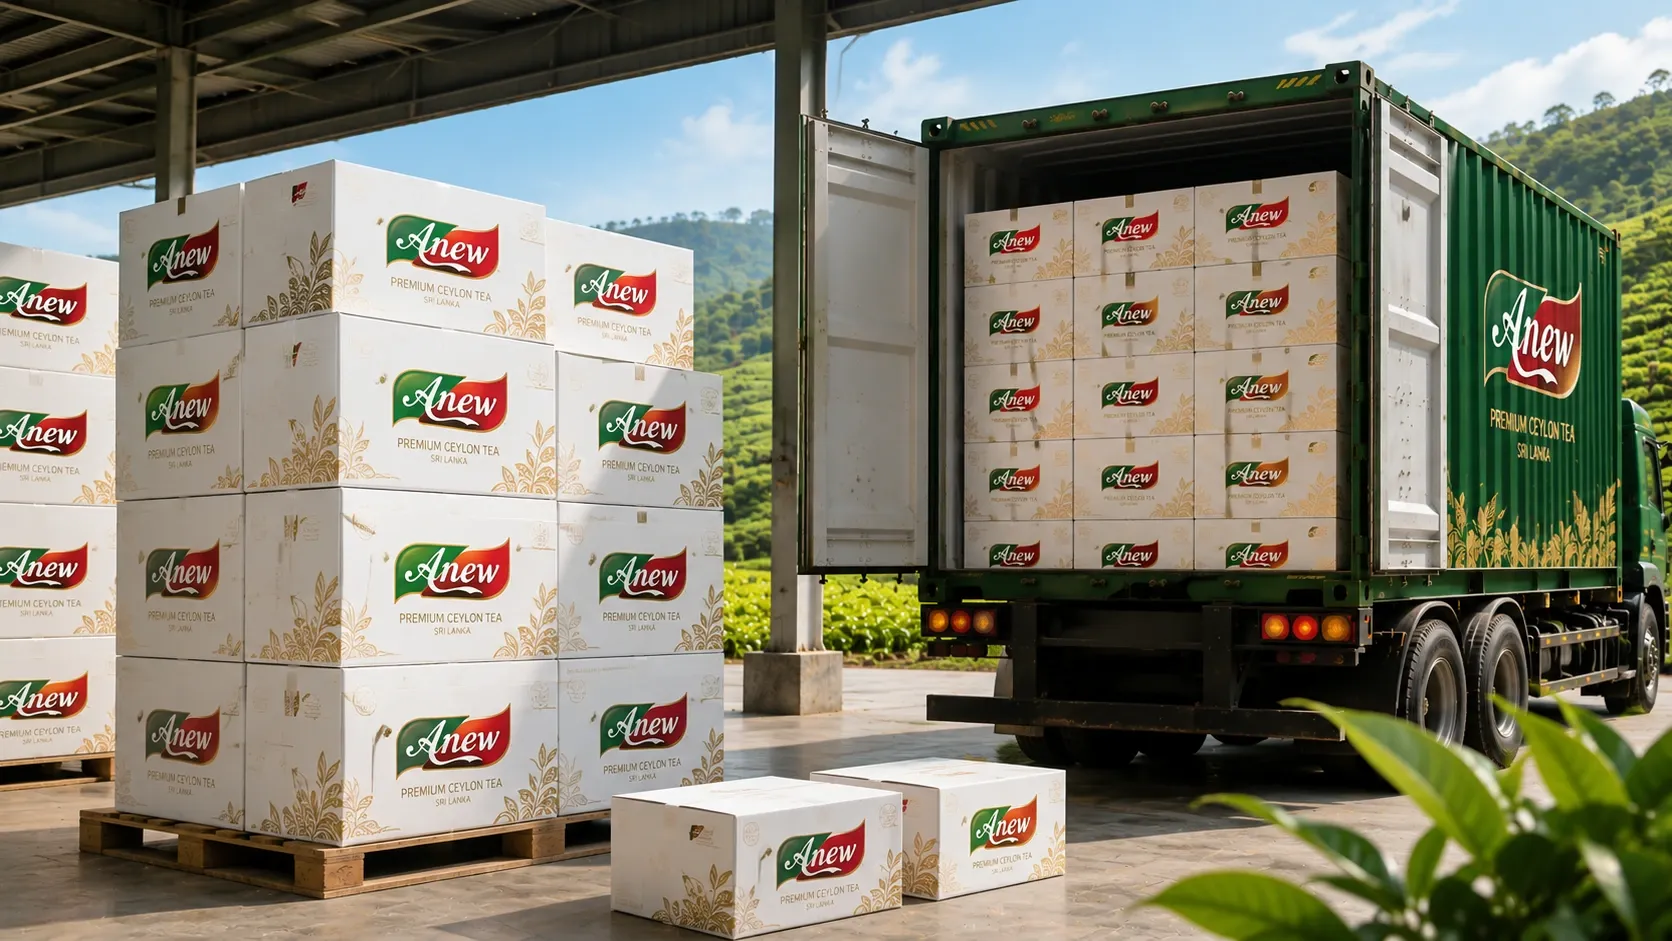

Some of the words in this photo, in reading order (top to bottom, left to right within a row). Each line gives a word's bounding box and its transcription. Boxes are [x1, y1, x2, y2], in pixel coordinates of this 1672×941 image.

[1231, 205, 1282, 227] Anew
[1106, 219, 1153, 239] Anew
[396, 222, 490, 273] Anew
[993, 232, 1035, 252] Anew
[153, 240, 212, 279] Anew
[149, 295, 177, 308] PREMIUM
[179, 292, 201, 304] CEYLON
[202, 288, 215, 299] TEA
[390, 276, 434, 292] PREMIUM
[438, 285, 472, 299] CEYLON
[475, 291, 492, 302] TEA
[581, 270, 648, 311] Anew
[0, 282, 77, 322] Anew
[424, 296, 435, 304] SRI
[436, 298, 460, 308] LANKA
[1231, 292, 1282, 314] Anew
[993, 312, 1034, 332] Anew
[1106, 304, 1152, 324] Anew
[0, 328, 30, 338] EMIUM
[33, 332, 64, 343] CEYLON
[66, 336, 80, 344] TEA
[577, 316, 610, 328] PREMIUM
[612, 322, 637, 334] CEYLON
[639, 326, 651, 336] TEA
[1492, 288, 1574, 385] Anew
[1106, 384, 1153, 404] Anew
[1231, 377, 1282, 399] Anew
[152, 387, 212, 430] Anew
[402, 376, 497, 426] Anew
[994, 390, 1035, 410] Anew
[0, 414, 77, 452] Anew
[606, 405, 678, 448] Anew
[1490, 408, 1527, 433] PREMIUM
[1528, 416, 1560, 440] CEYLON
[1560, 422, 1575, 443] TEA
[148, 448, 176, 460] PREMIUM
[177, 446, 201, 456] CEYLON
[203, 444, 215, 454] TEA
[397, 437, 441, 451] PREMIUM
[444, 442, 480, 454] CEYLON
[483, 445, 500, 456] TEA
[1517, 443, 1528, 459] SRI
[1529, 445, 1551, 462] LANKA
[0, 462, 30, 472] EMIUM
[32, 465, 62, 474] CEYLON
[65, 467, 80, 475] TEA
[430, 454, 442, 462] SRI
[444, 455, 468, 464] LANKA
[602, 460, 636, 470] PREMIUM
[637, 462, 665, 473] CEYLON
[667, 465, 680, 474] TEA
[993, 470, 1035, 490] Anew
[1106, 467, 1152, 488] Anew
[1231, 463, 1282, 485] Anew
[993, 545, 1035, 565] Anew
[1106, 545, 1152, 566] Anew
[1231, 544, 1282, 566] Anew
[0, 550, 78, 585] Anew
[152, 551, 212, 594] Anew
[405, 547, 500, 594] Anew
[607, 556, 678, 596] Anew
[0, 600, 30, 608] EMIUM
[33, 600, 64, 608] CEYLON
[148, 611, 176, 620] PREMIUM
[178, 612, 201, 621] CEYLON
[203, 612, 216, 622] TEA
[400, 613, 444, 623] PREMIUM
[447, 613, 482, 623] CEYLON
[485, 612, 502, 622] TEA
[603, 612, 636, 621] PREMIUM
[638, 612, 665, 621] CEYLON
[667, 612, 680, 620] TEA
[434, 627, 446, 635] SRI
[0, 682, 78, 716] Anew
[0, 730, 31, 738] REMIUM
[34, 727, 64, 736] CEYLON
[67, 726, 81, 734] TEA
[607, 706, 679, 746] Anew
[152, 714, 212, 759] Anew
[406, 720, 500, 766] Anew
[604, 763, 638, 774] PREMIUM
[640, 760, 666, 770] CEYLON
[668, 758, 681, 767] TEA
[147, 770, 176, 782] PREMIUM
[177, 774, 201, 786] CEYLON
[203, 778, 216, 788] TEA
[401, 784, 445, 798] PREMIUM
[448, 780, 483, 794] CEYLON
[486, 778, 502, 788] TEA
[436, 798, 446, 806] SRI
[448, 796, 471, 805] LANKA
[976, 809, 1030, 845] Anew
[784, 837, 856, 876] Anew
[780, 891, 814, 904] PREMIUM
[817, 885, 845, 899] CEYLON
[847, 884, 860, 893] TEA
